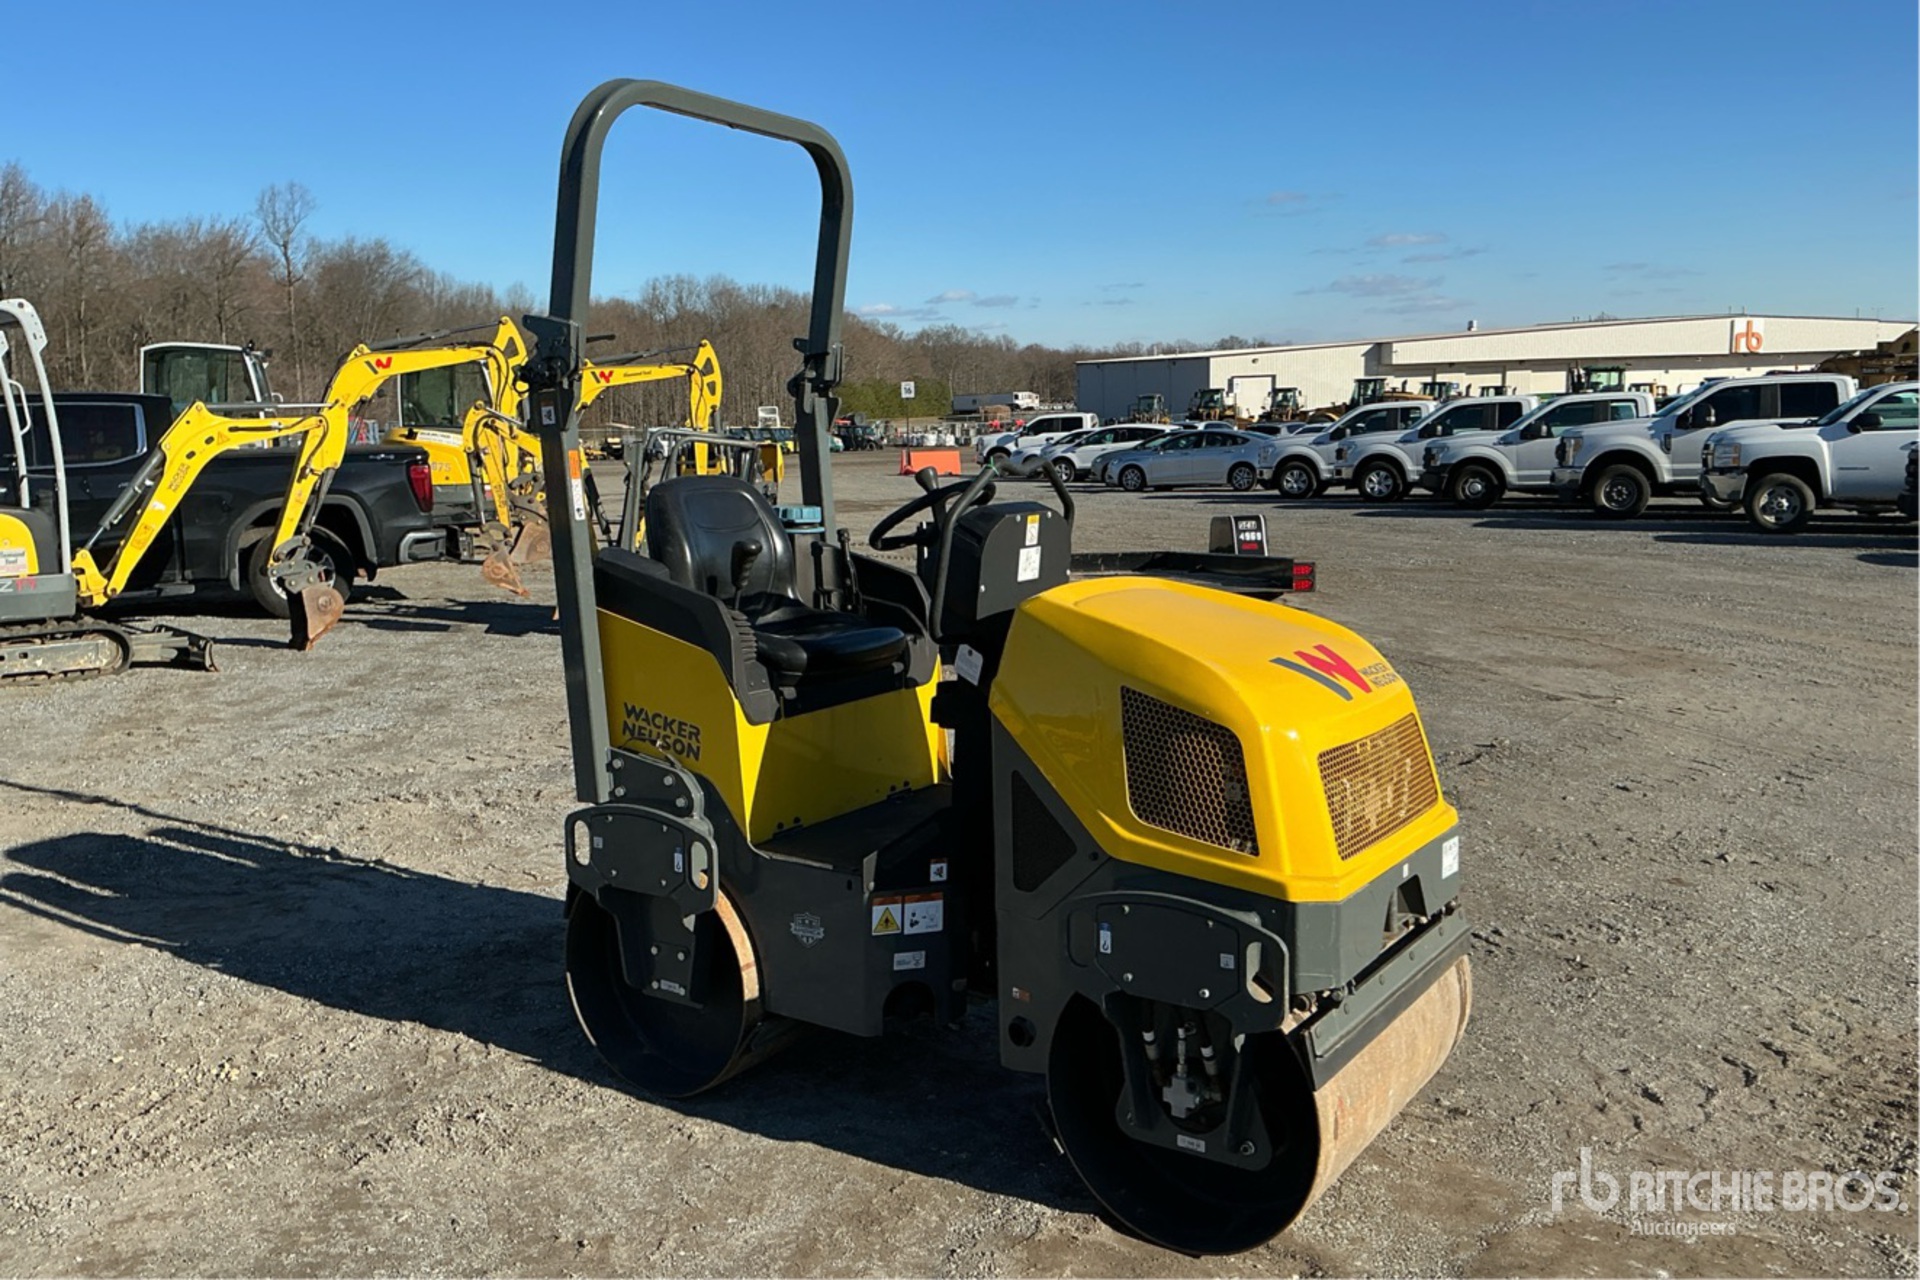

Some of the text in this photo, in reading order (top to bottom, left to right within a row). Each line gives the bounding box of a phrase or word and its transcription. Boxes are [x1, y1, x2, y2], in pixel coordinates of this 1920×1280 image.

[1735, 320, 1763, 353] rb
[622, 720, 701, 762] NEUSON
[623, 701, 701, 745] WACKER
